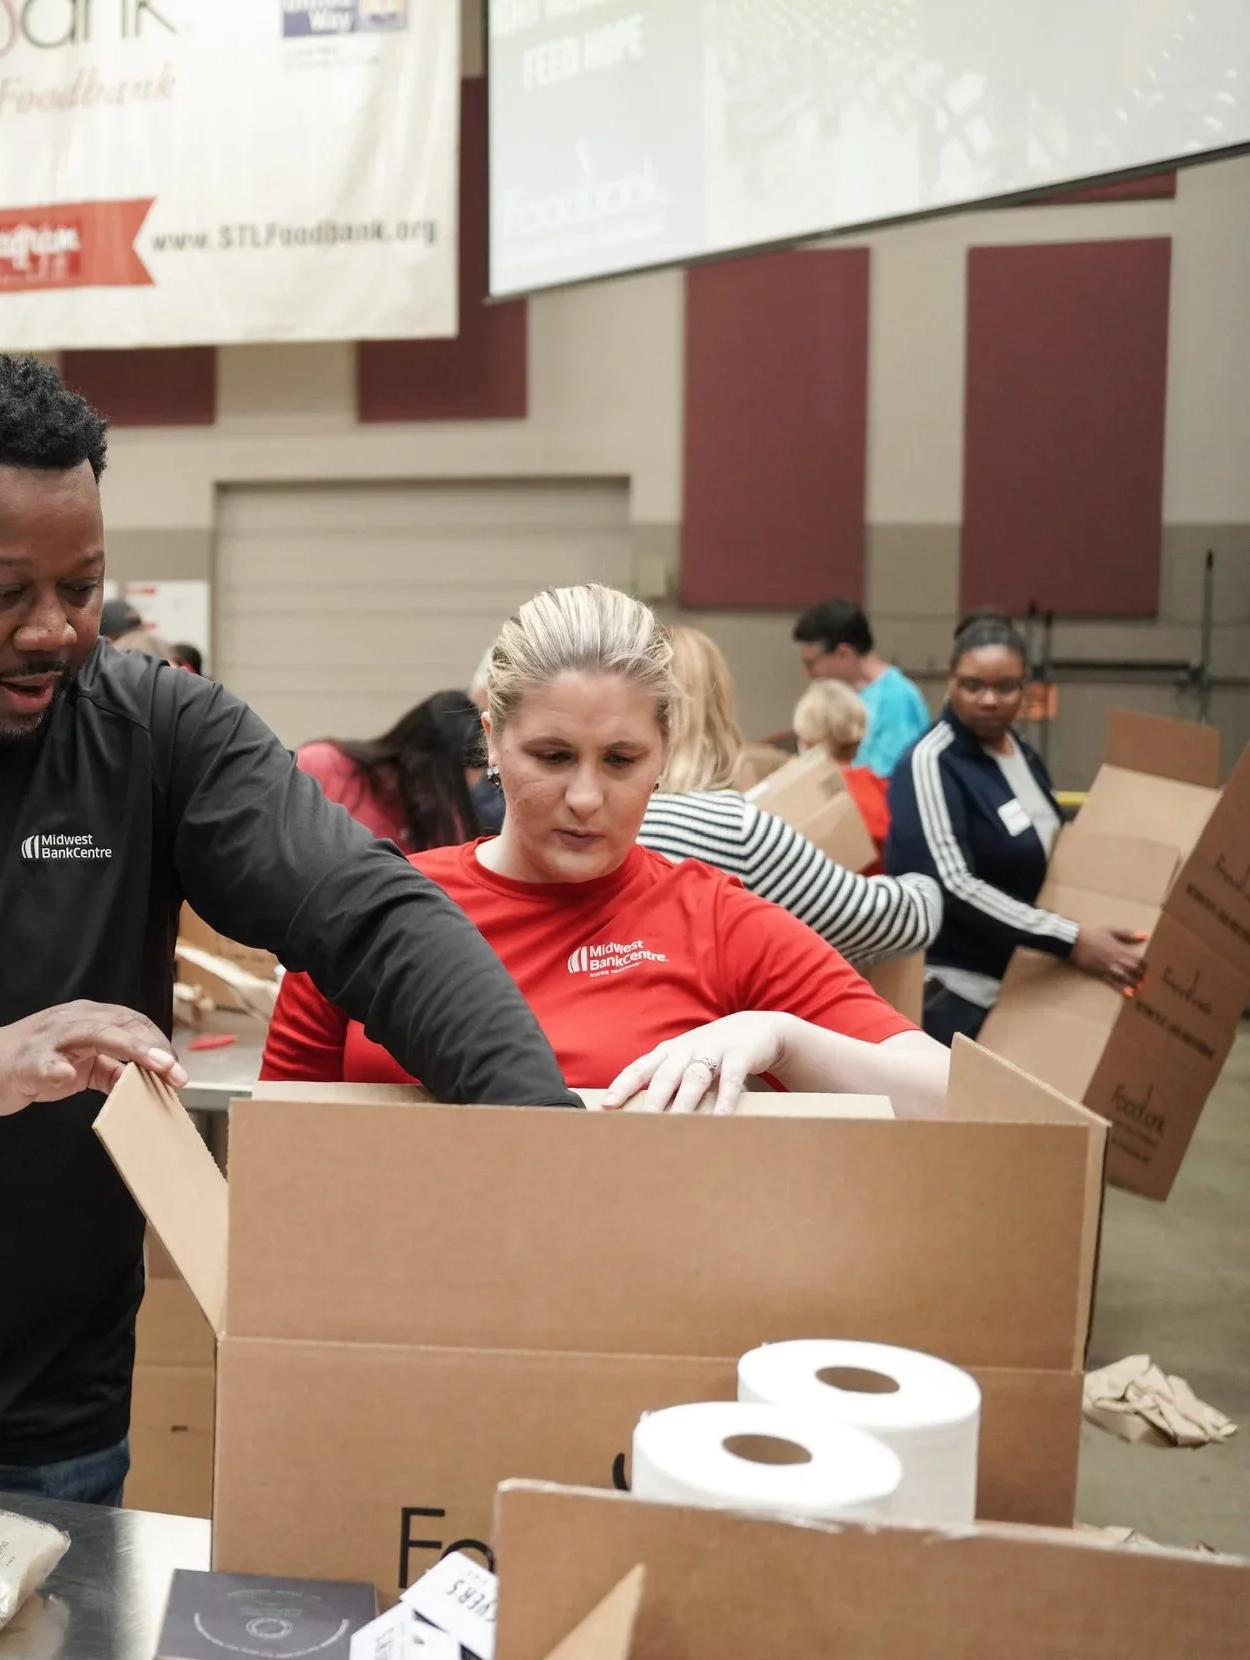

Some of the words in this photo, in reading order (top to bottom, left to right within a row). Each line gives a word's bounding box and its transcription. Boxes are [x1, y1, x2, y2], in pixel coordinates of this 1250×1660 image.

[522, 36, 580, 90] FEED
[41, 834, 93, 846] Midwest
[41, 847, 113, 859] BankCentre
[589, 939, 644, 958] Midwest
